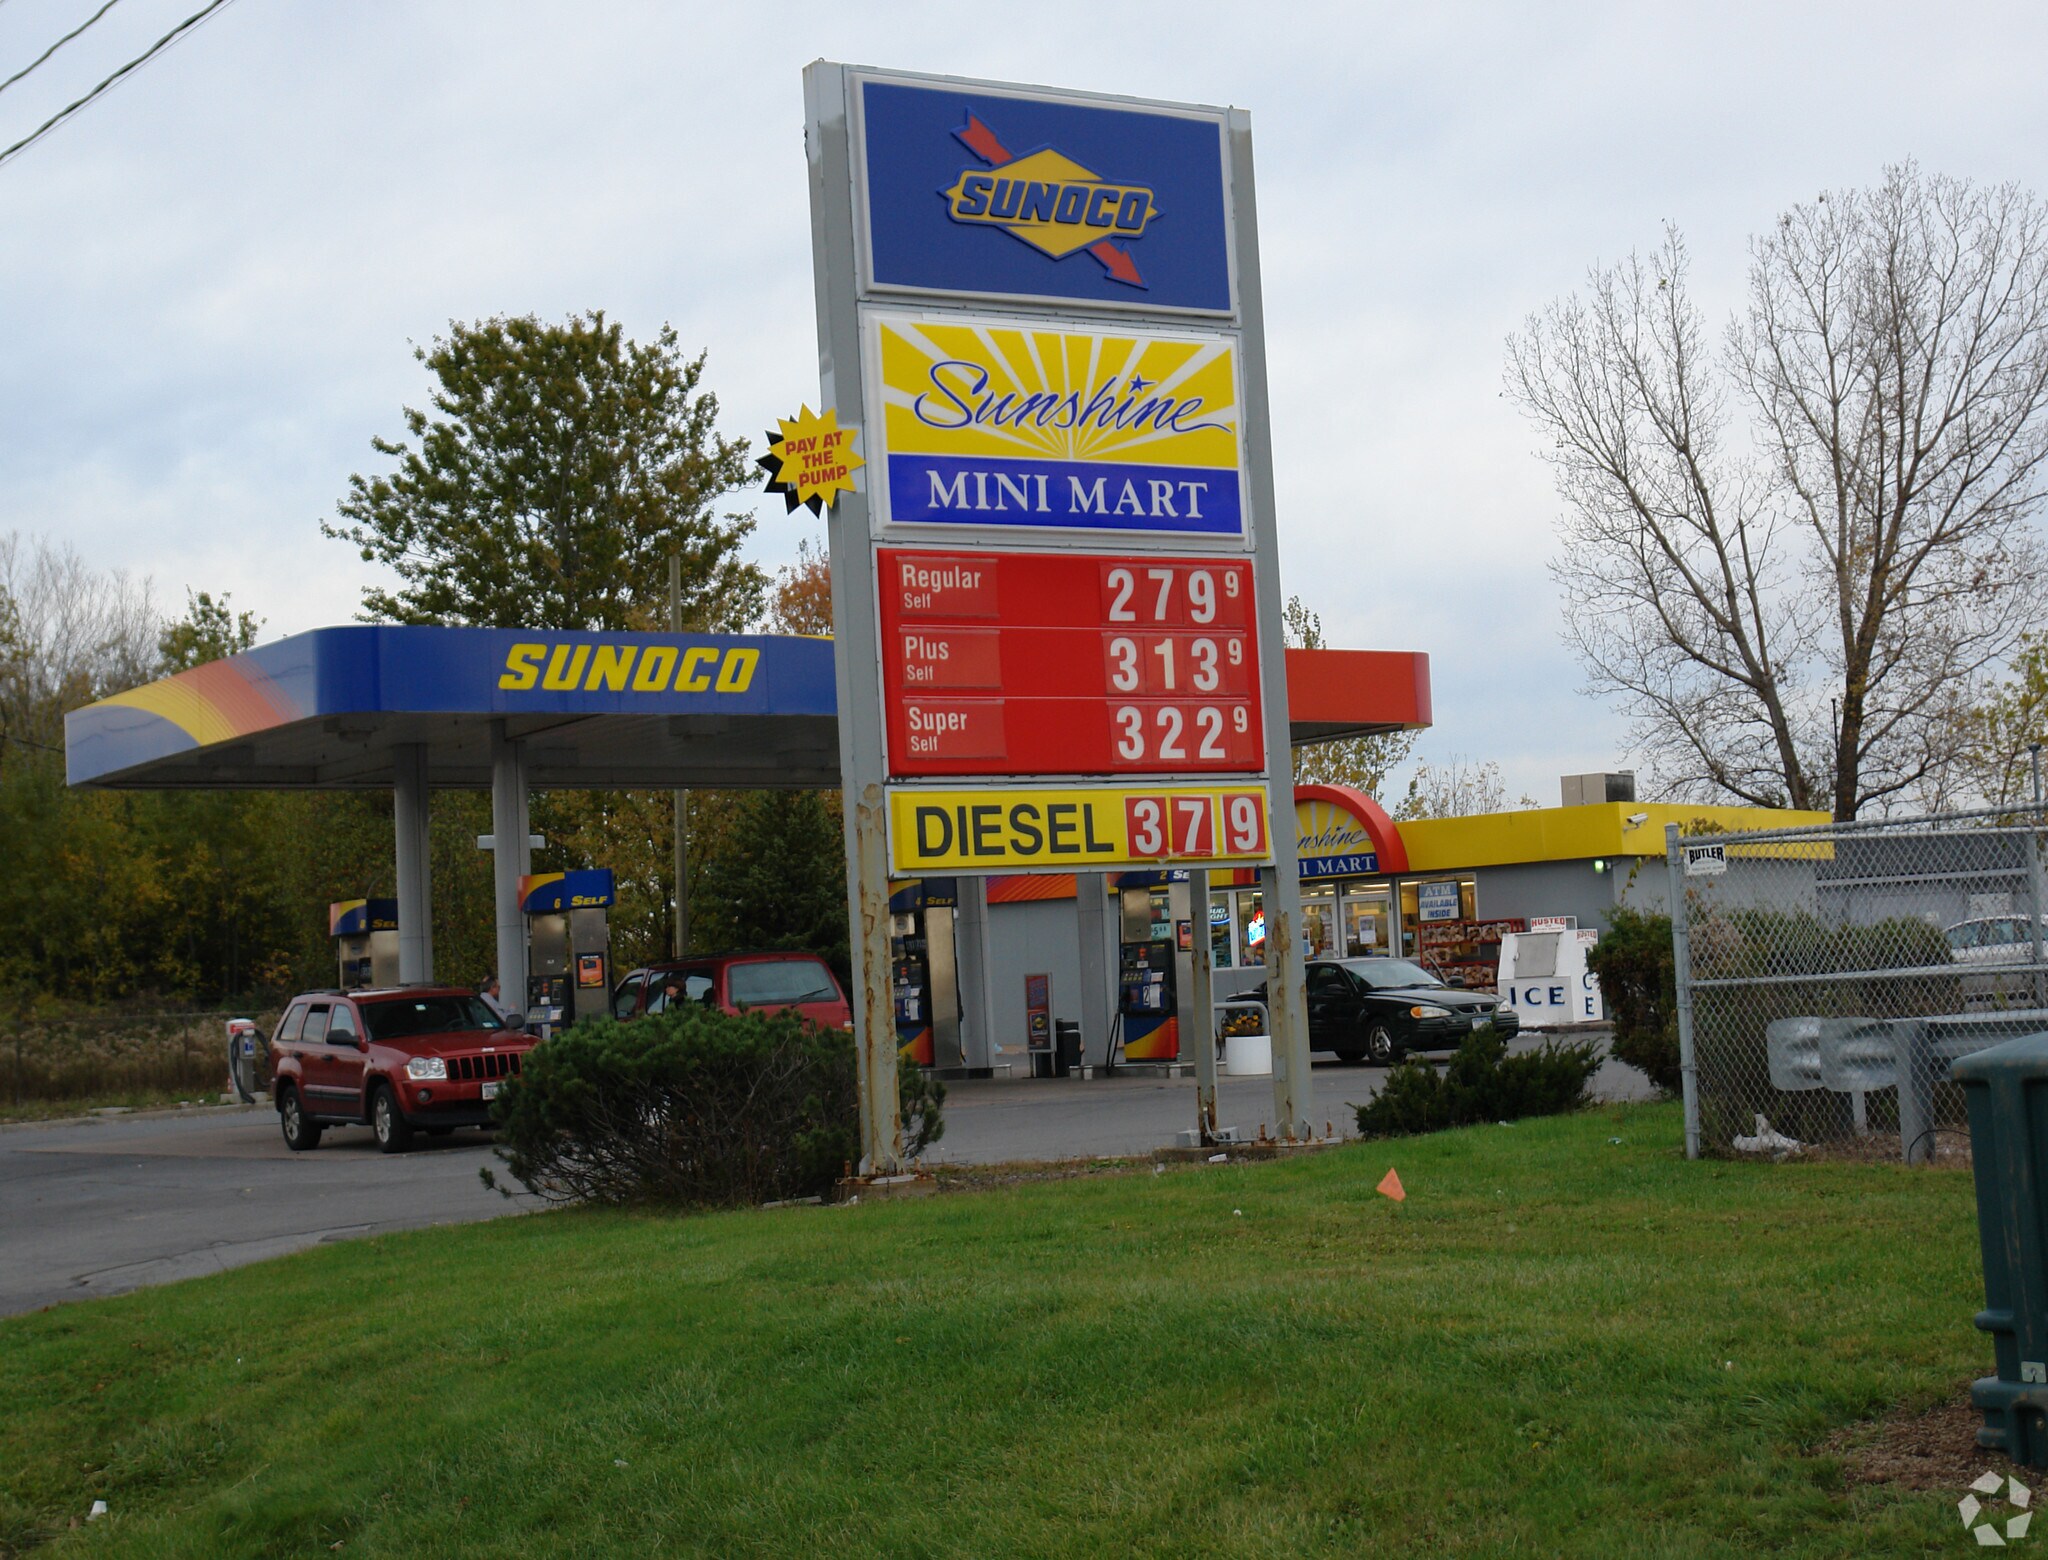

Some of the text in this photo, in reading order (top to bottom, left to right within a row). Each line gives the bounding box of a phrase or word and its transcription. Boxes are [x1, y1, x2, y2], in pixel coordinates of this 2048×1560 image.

[957, 175, 1151, 230] SUNOCO
[914, 361, 1233, 434] Sunshine
[785, 431, 843, 456] PAY AT
[802, 450, 834, 468] THE
[798, 465, 848, 487] PUMP
[926, 470, 1208, 519] MINI MART
[902, 564, 982, 592] Regular
[903, 592, 931, 609] Self
[904, 636, 950, 660] Plus
[498, 643, 760, 693] SUNOCO
[906, 664, 934, 681] Self
[908, 706, 968, 738] Super
[910, 735, 938, 752] Self
[915, 803, 1115, 858] DIESEL
[1297, 827, 1371, 849] nshine
[1317, 856, 1375, 874] MART
[1689, 847, 1725, 865] BUTLER
[1160, 870, 1189, 880] 2 SE
[1424, 885, 1451, 897] ATM
[571, 895, 608, 906] SELF
[1420, 898, 1457, 909] AVAILABLE
[1427, 909, 1451, 918] INSIDE
[1531, 917, 1565, 927] HUSTED
[1143, 986, 1149, 1004] 2
[1510, 986, 1565, 1006] ICE
